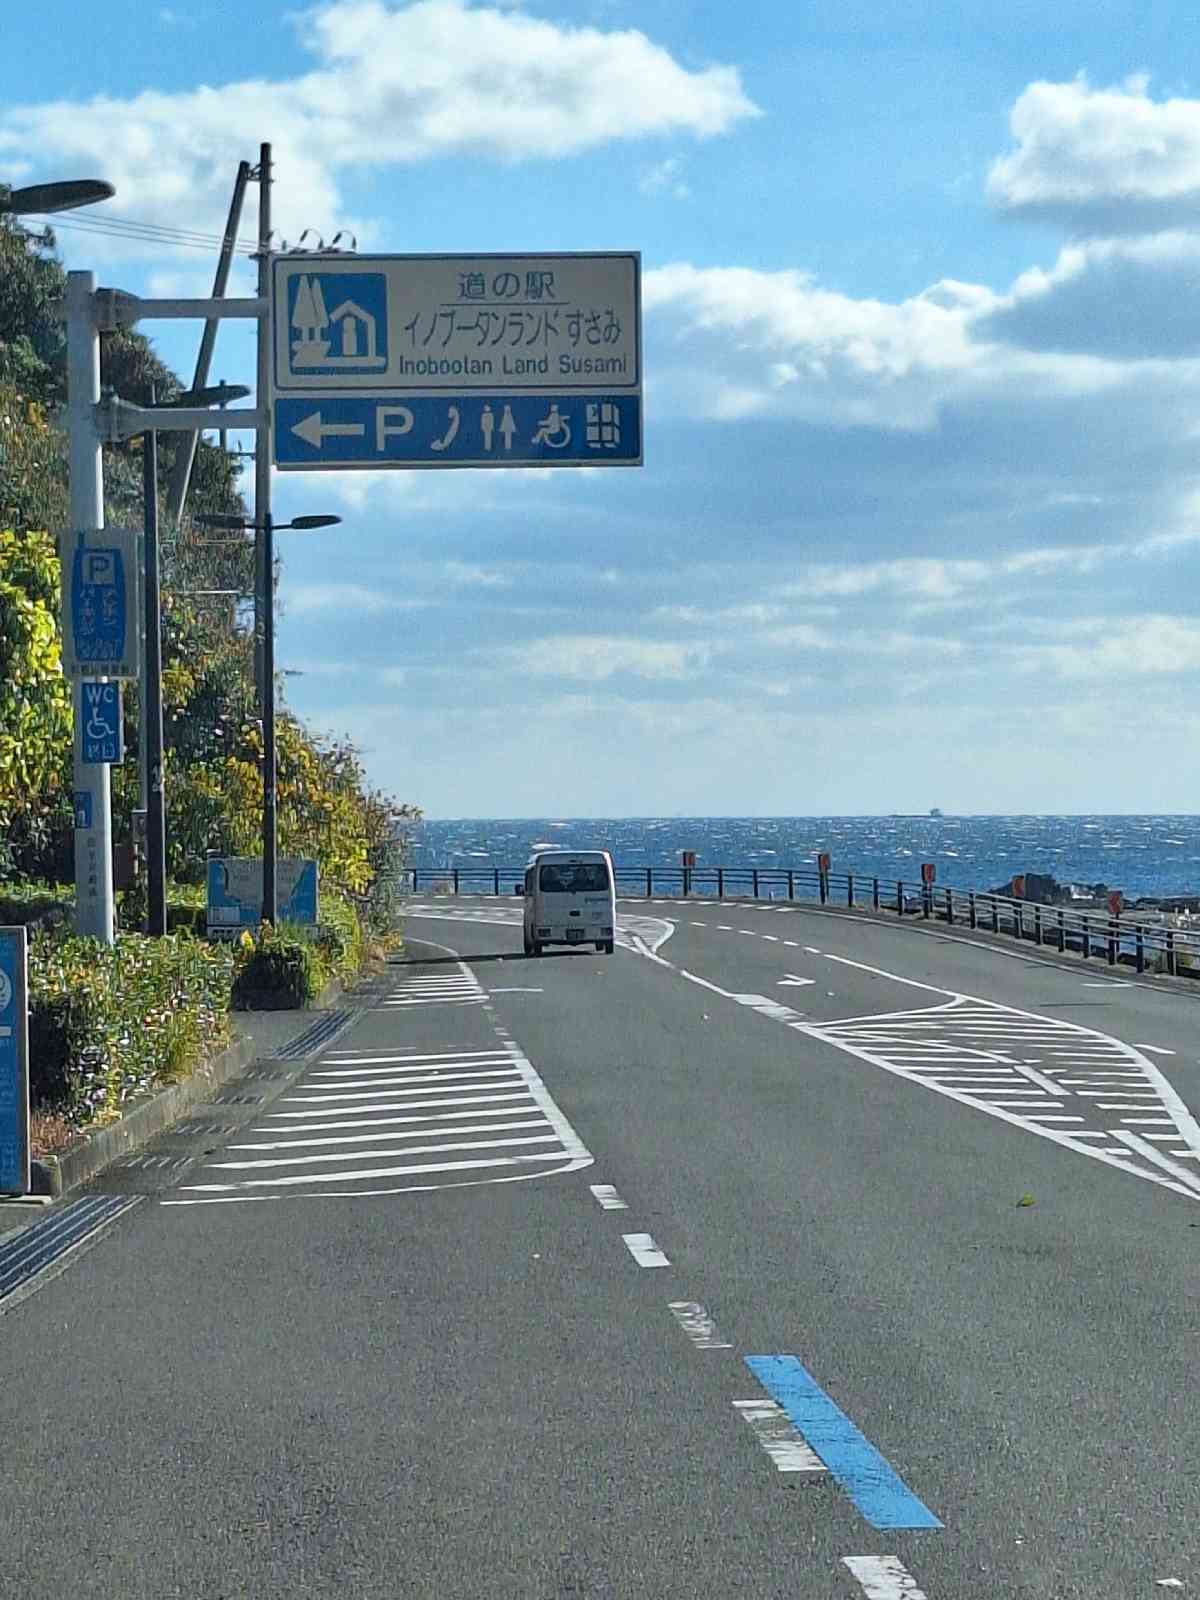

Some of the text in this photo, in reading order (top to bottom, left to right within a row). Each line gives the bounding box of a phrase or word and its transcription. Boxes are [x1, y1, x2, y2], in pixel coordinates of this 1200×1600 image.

[457, 271, 555, 300] 道の駅
[399, 354, 626, 375] Inobootan Land Susami
[375, 406, 415, 451] P
[89, 556, 109, 582] P
[86, 686, 115, 704] WC
